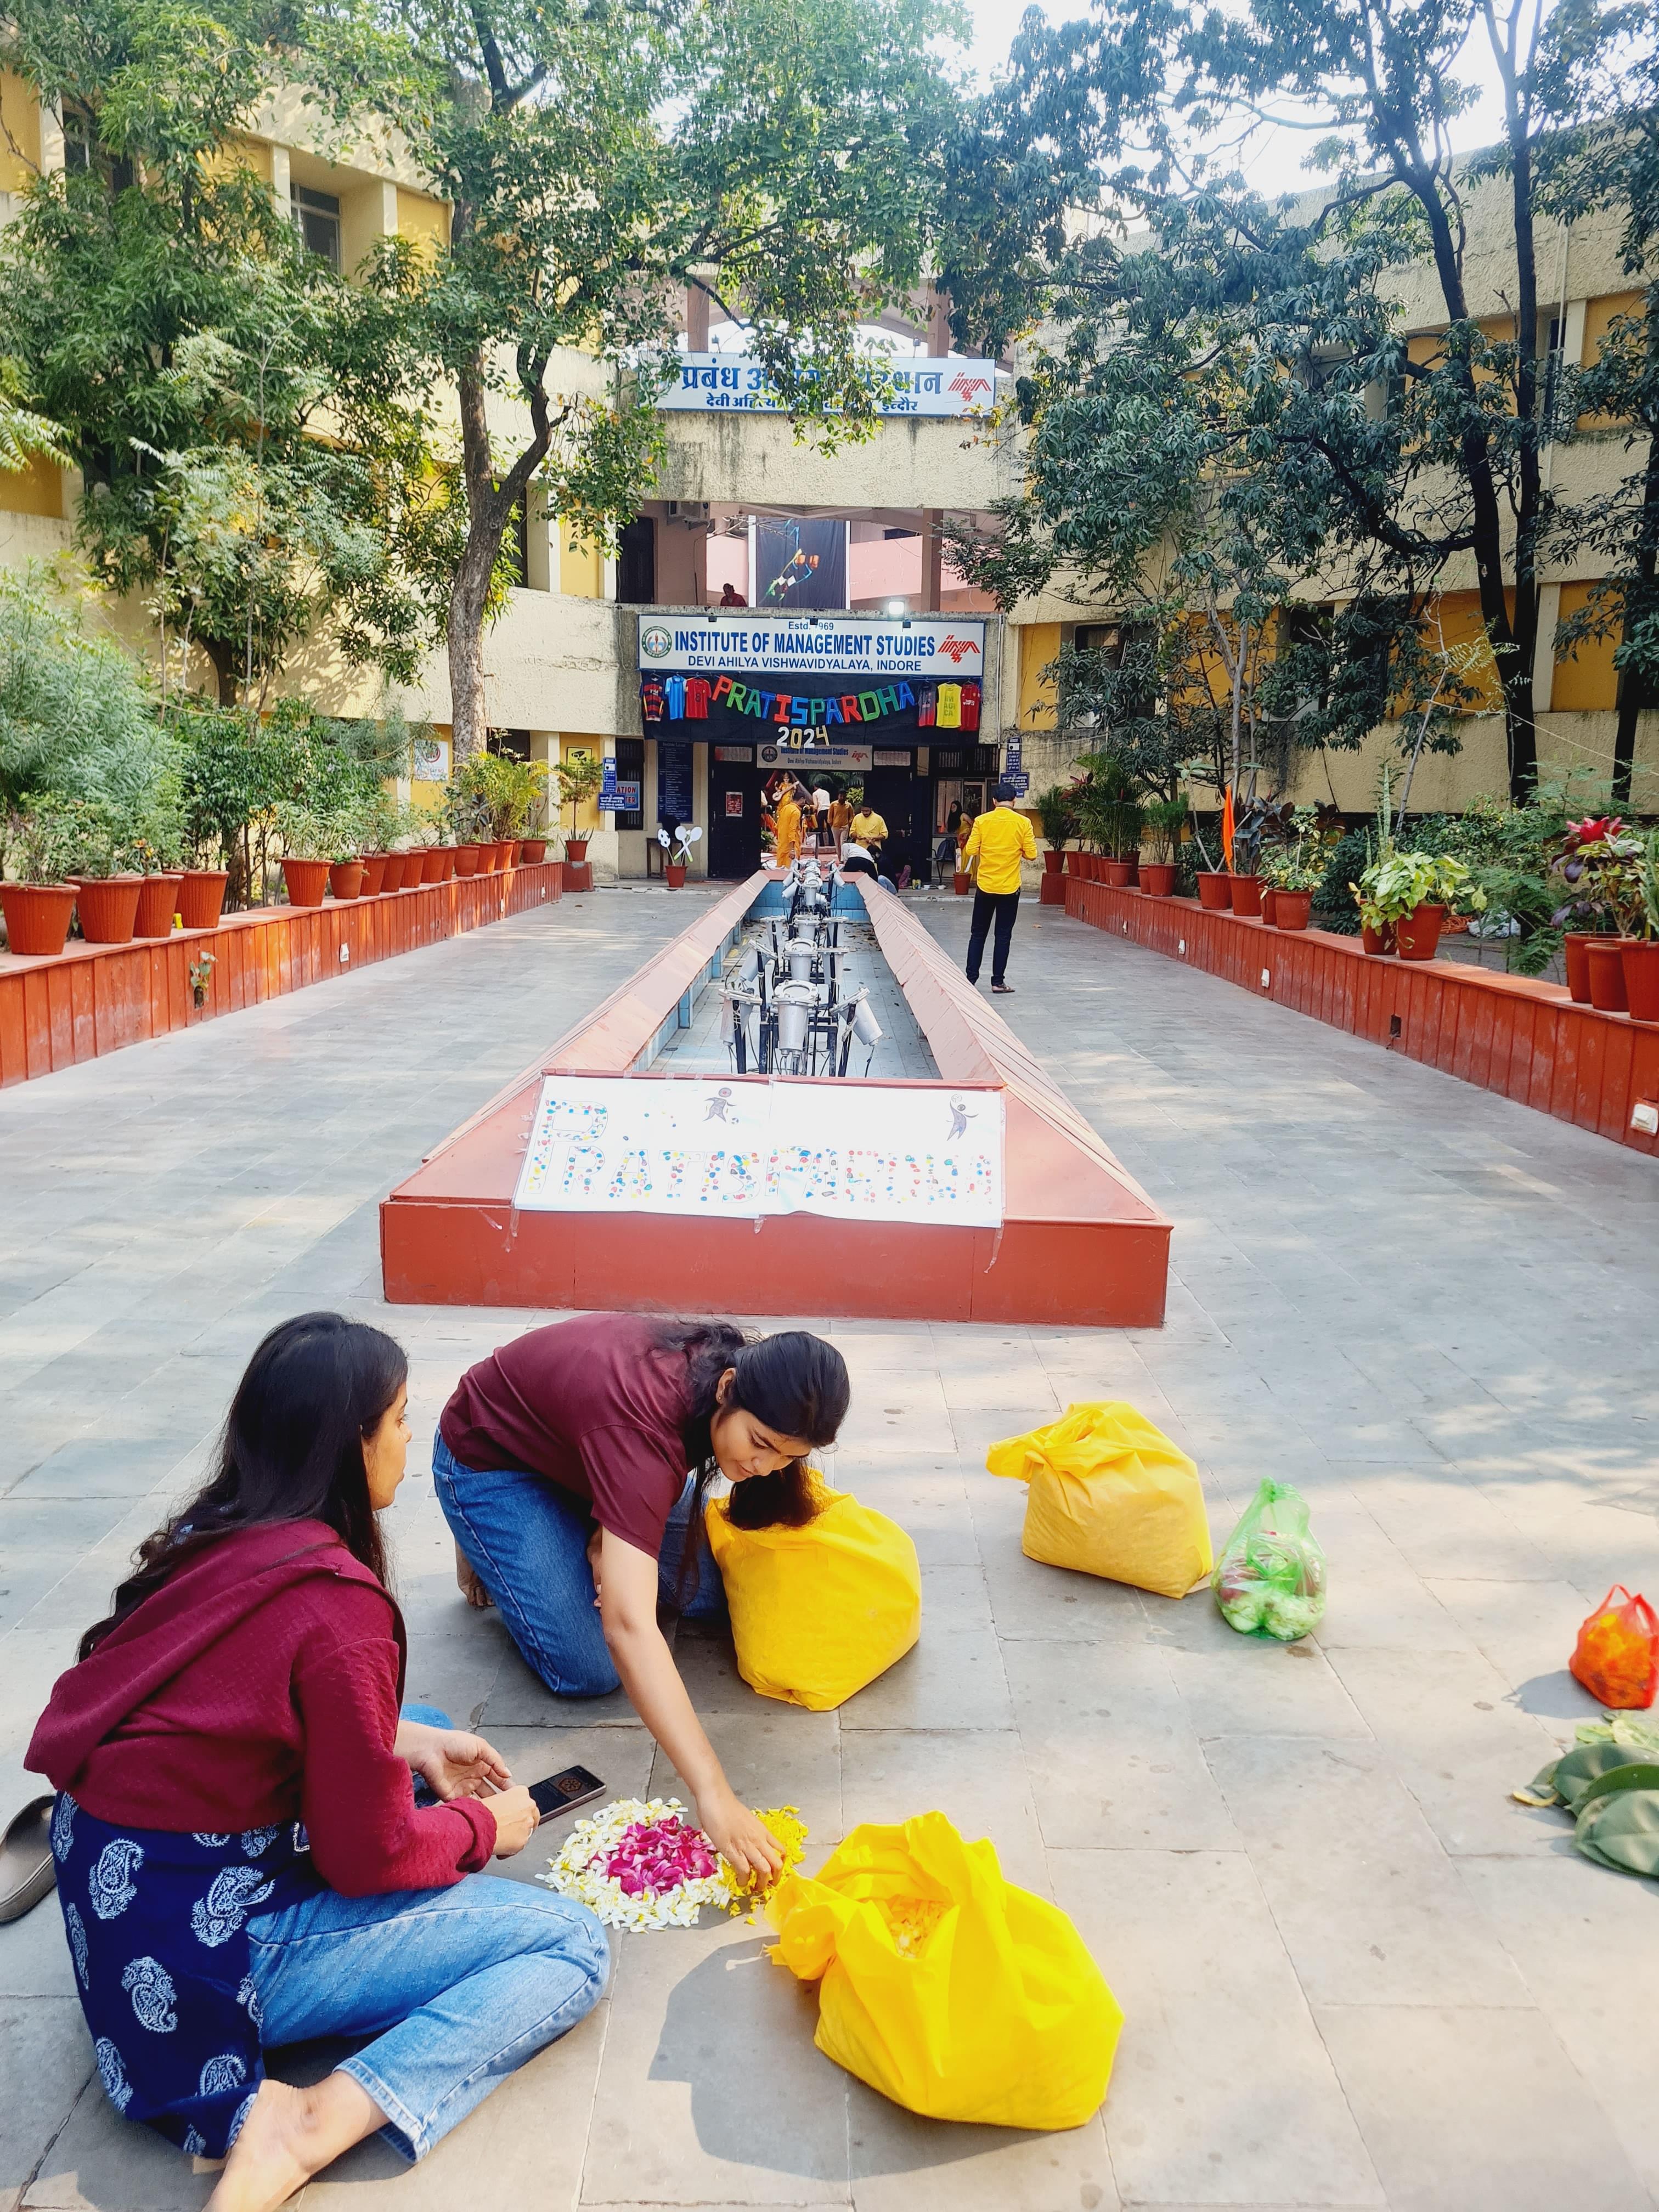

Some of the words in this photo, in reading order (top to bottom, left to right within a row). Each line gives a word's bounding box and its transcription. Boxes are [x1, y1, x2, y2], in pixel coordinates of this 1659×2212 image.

[681, 358, 741, 390] प्रबंध
[706, 392, 730, 407] देवी
[882, 396, 918, 411] इन्दौर
[788, 621, 811, 630] Estd.
[675, 631, 748, 652] INSTITUTE
[752, 633, 769, 652] OF
[774, 633, 872, 655] MANAGEMENT
[876, 635, 935, 657] STUDIES
[689, 656, 714, 667] DEVI
[718, 657, 758, 667] AHILYA
[761, 658, 873, 672] VISHWAVIDYALAYA,
[877, 660, 921, 671] INDORE
[711, 675, 916, 725] PRATISPARDHA
[776, 725, 830, 749] 2024
